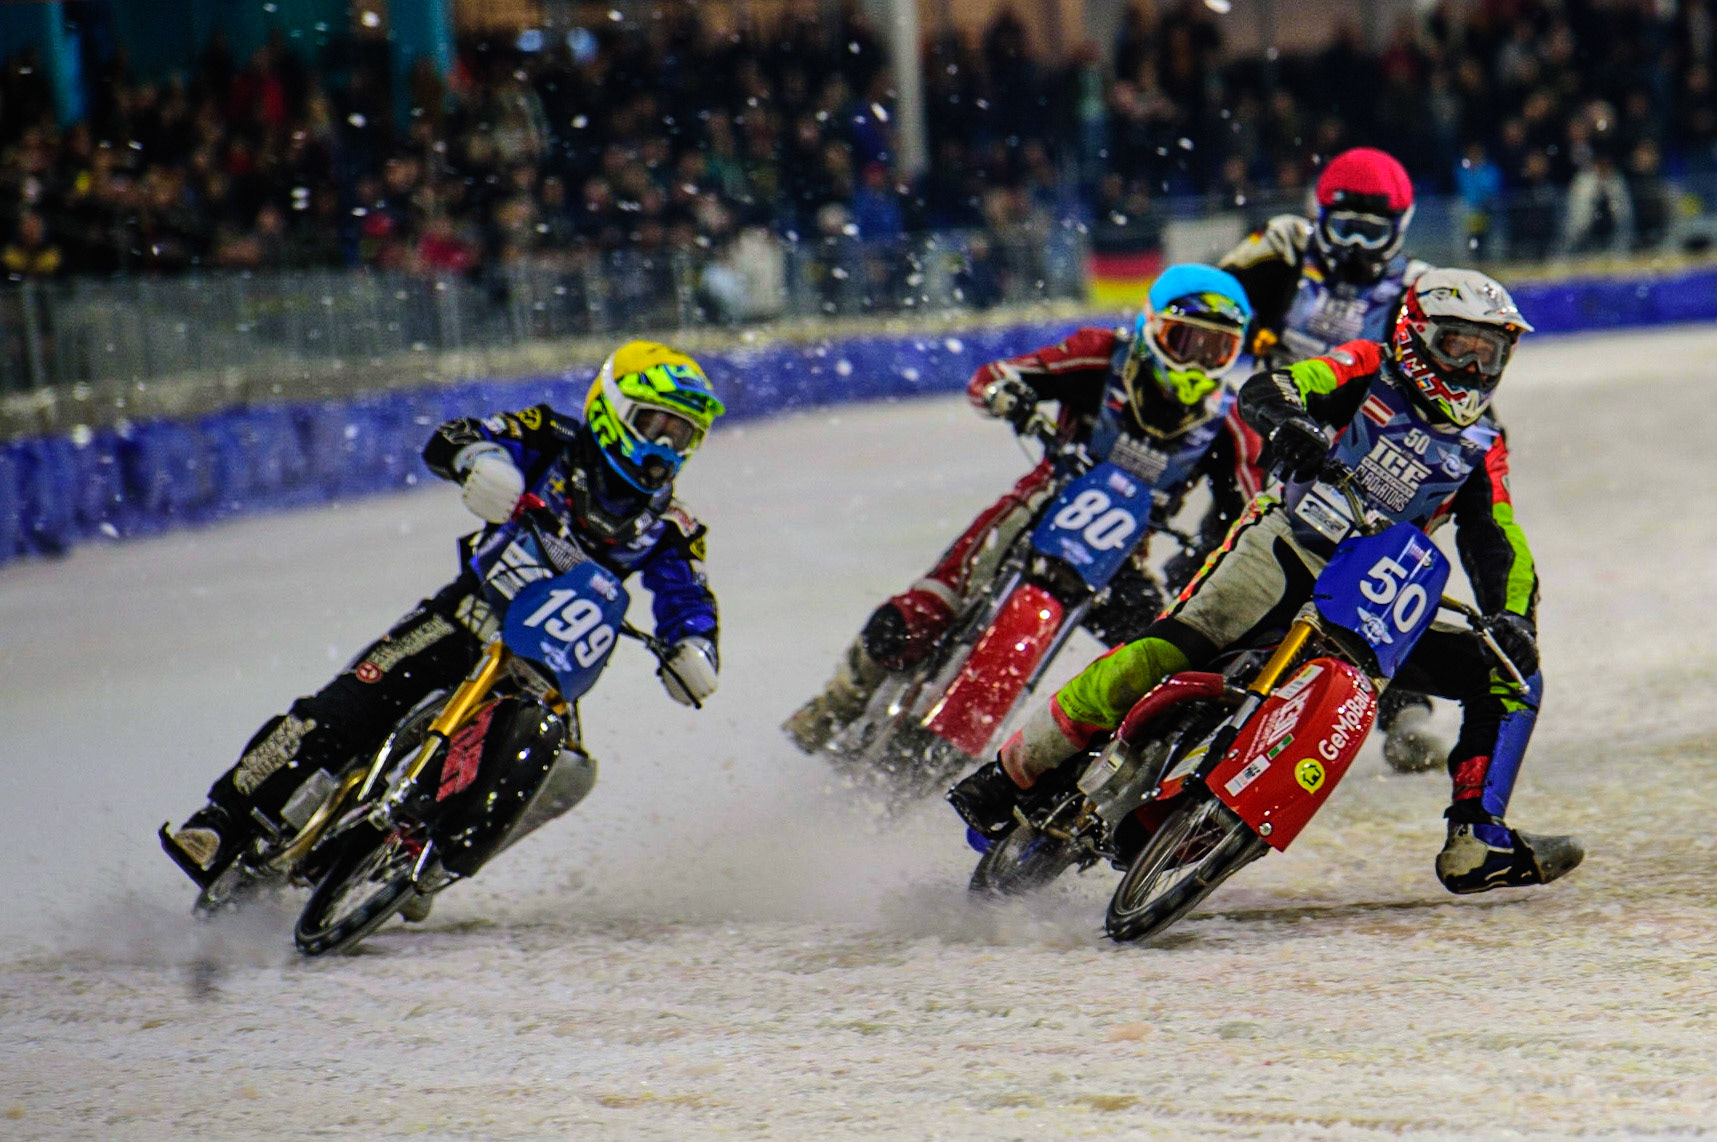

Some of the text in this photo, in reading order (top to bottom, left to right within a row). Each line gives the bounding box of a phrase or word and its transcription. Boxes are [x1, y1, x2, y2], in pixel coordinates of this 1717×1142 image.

[1368, 440, 1428, 490] ICE
[1403, 427, 1431, 456] 50
[1054, 488, 1137, 551] 80
[1359, 555, 1428, 634] 50
[522, 588, 615, 669] 199
